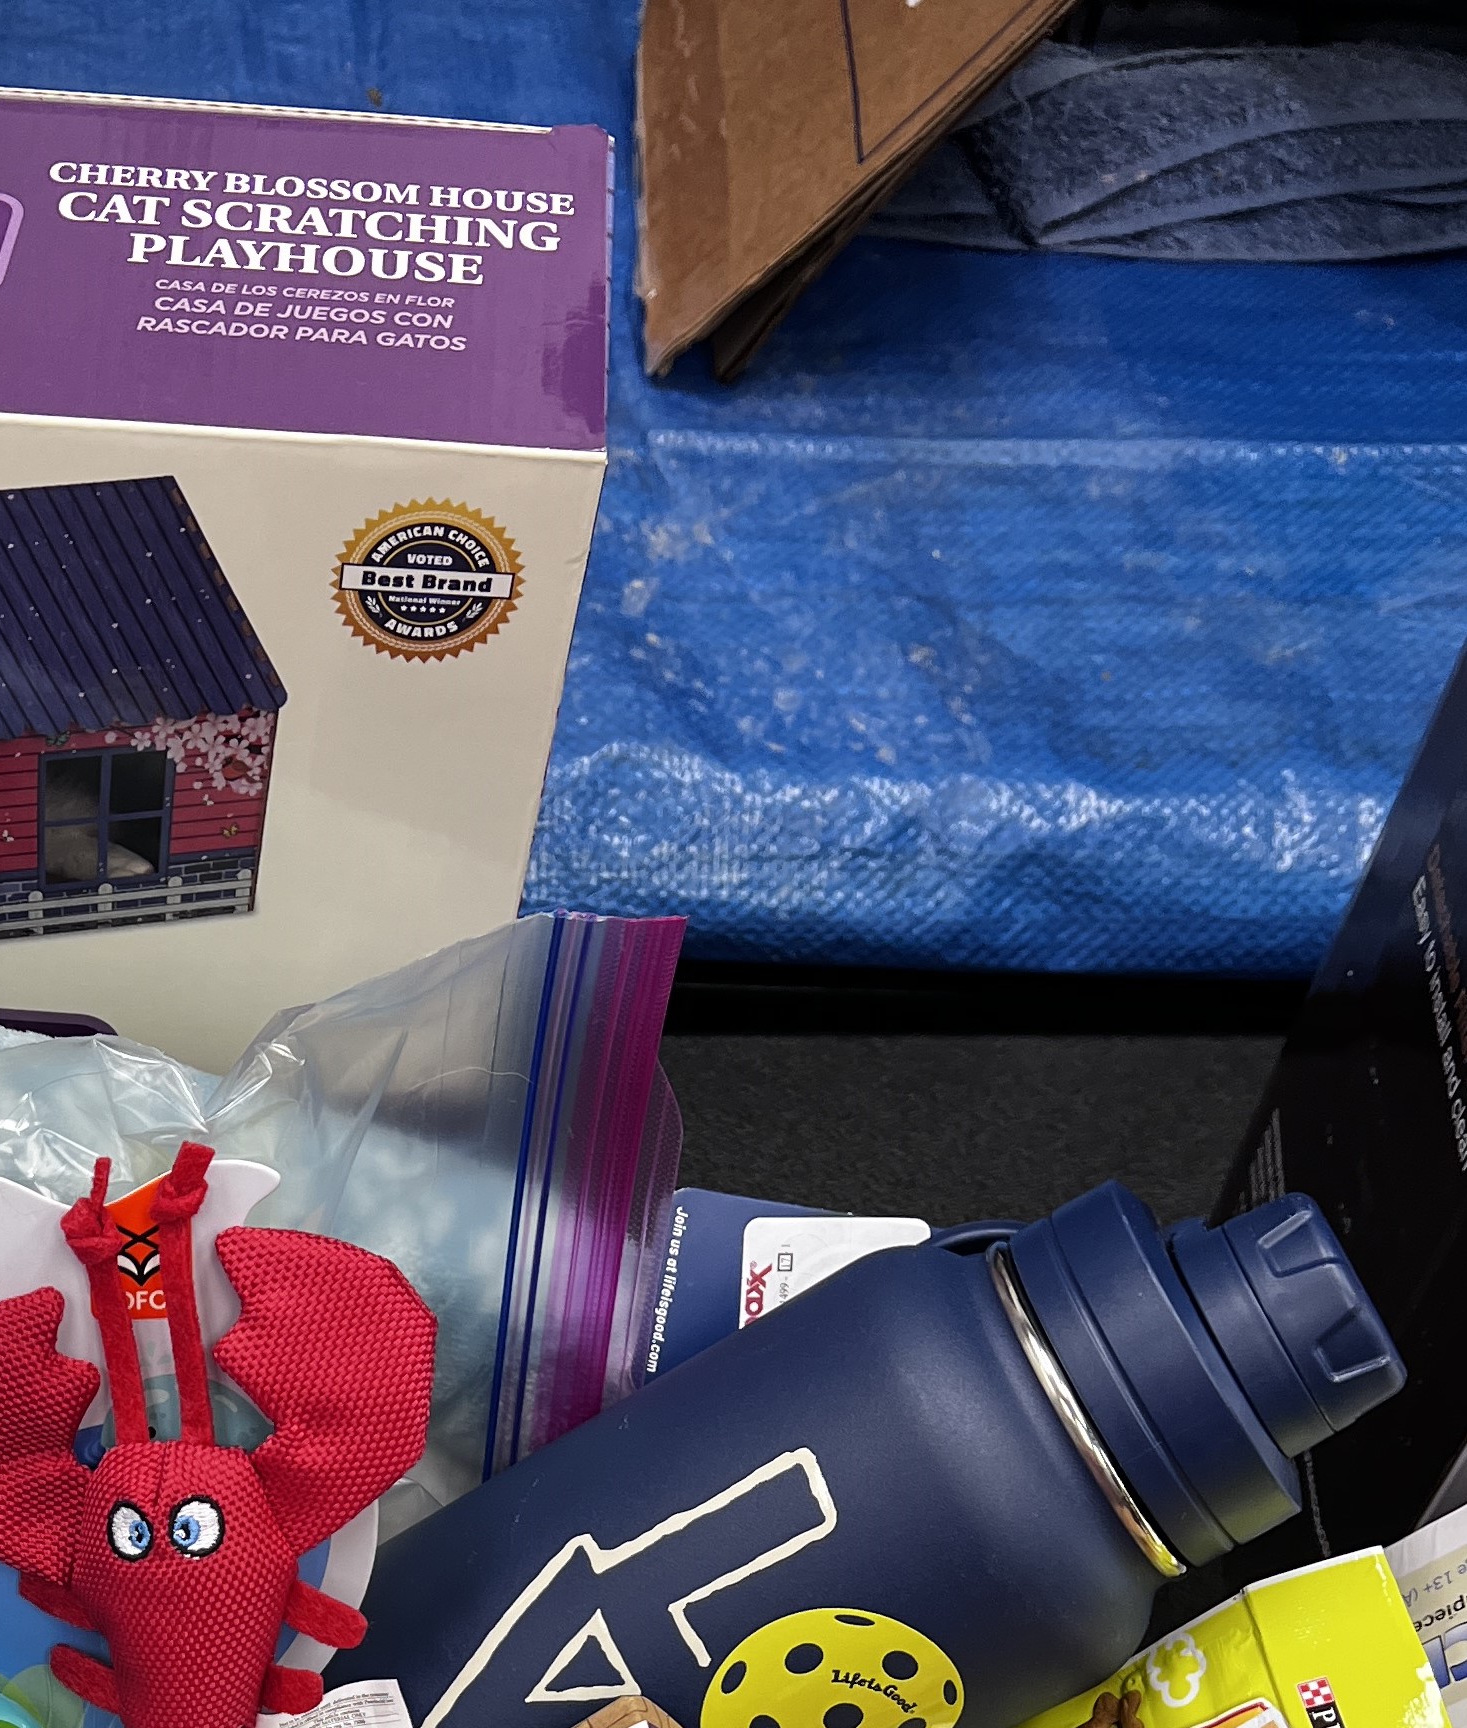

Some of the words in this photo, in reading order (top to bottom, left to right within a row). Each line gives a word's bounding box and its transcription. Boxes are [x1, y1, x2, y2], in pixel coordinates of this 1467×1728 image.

[49, 161, 218, 193] CHERRY
[223, 173, 421, 207] BLOSSOM
[430, 186, 575, 216] HOUSE
[58, 191, 171, 226] CAT
[181, 199, 562, 253] SCRATCHING
[127, 232, 484, 286] PLAYHOUSE
[154, 279, 205, 293] CASA
[210, 282, 238, 294] DE
[241, 284, 277, 297] LOS
[282, 287, 369, 303] CEREZOS
[374, 293, 400, 305] EN
[404, 295, 455, 309] FLOR
[154, 296, 226, 315] CASA
[234, 301, 273, 317] DE
[277, 304, 386, 324] JUEGOS
[394, 311, 454, 329] CON
[136, 316, 289, 340] RASCADOR
[295, 326, 368, 345] PARA
[376, 333, 468, 352] GATOS
[370, 525, 444, 563] AMERICAN
[448, 530, 490, 568] CHOICE
[406, 553, 453, 566] VOTED
[361, 571, 414, 588] Best
[422, 574, 493, 592] Brand
[384, 618, 458, 638] AWARDS
[676, 1206, 689, 1230] Join
[668, 1237, 681, 1256] us
[665, 1258, 677, 1275] at
[646, 1275, 675, 1374] lifeisgood.com
